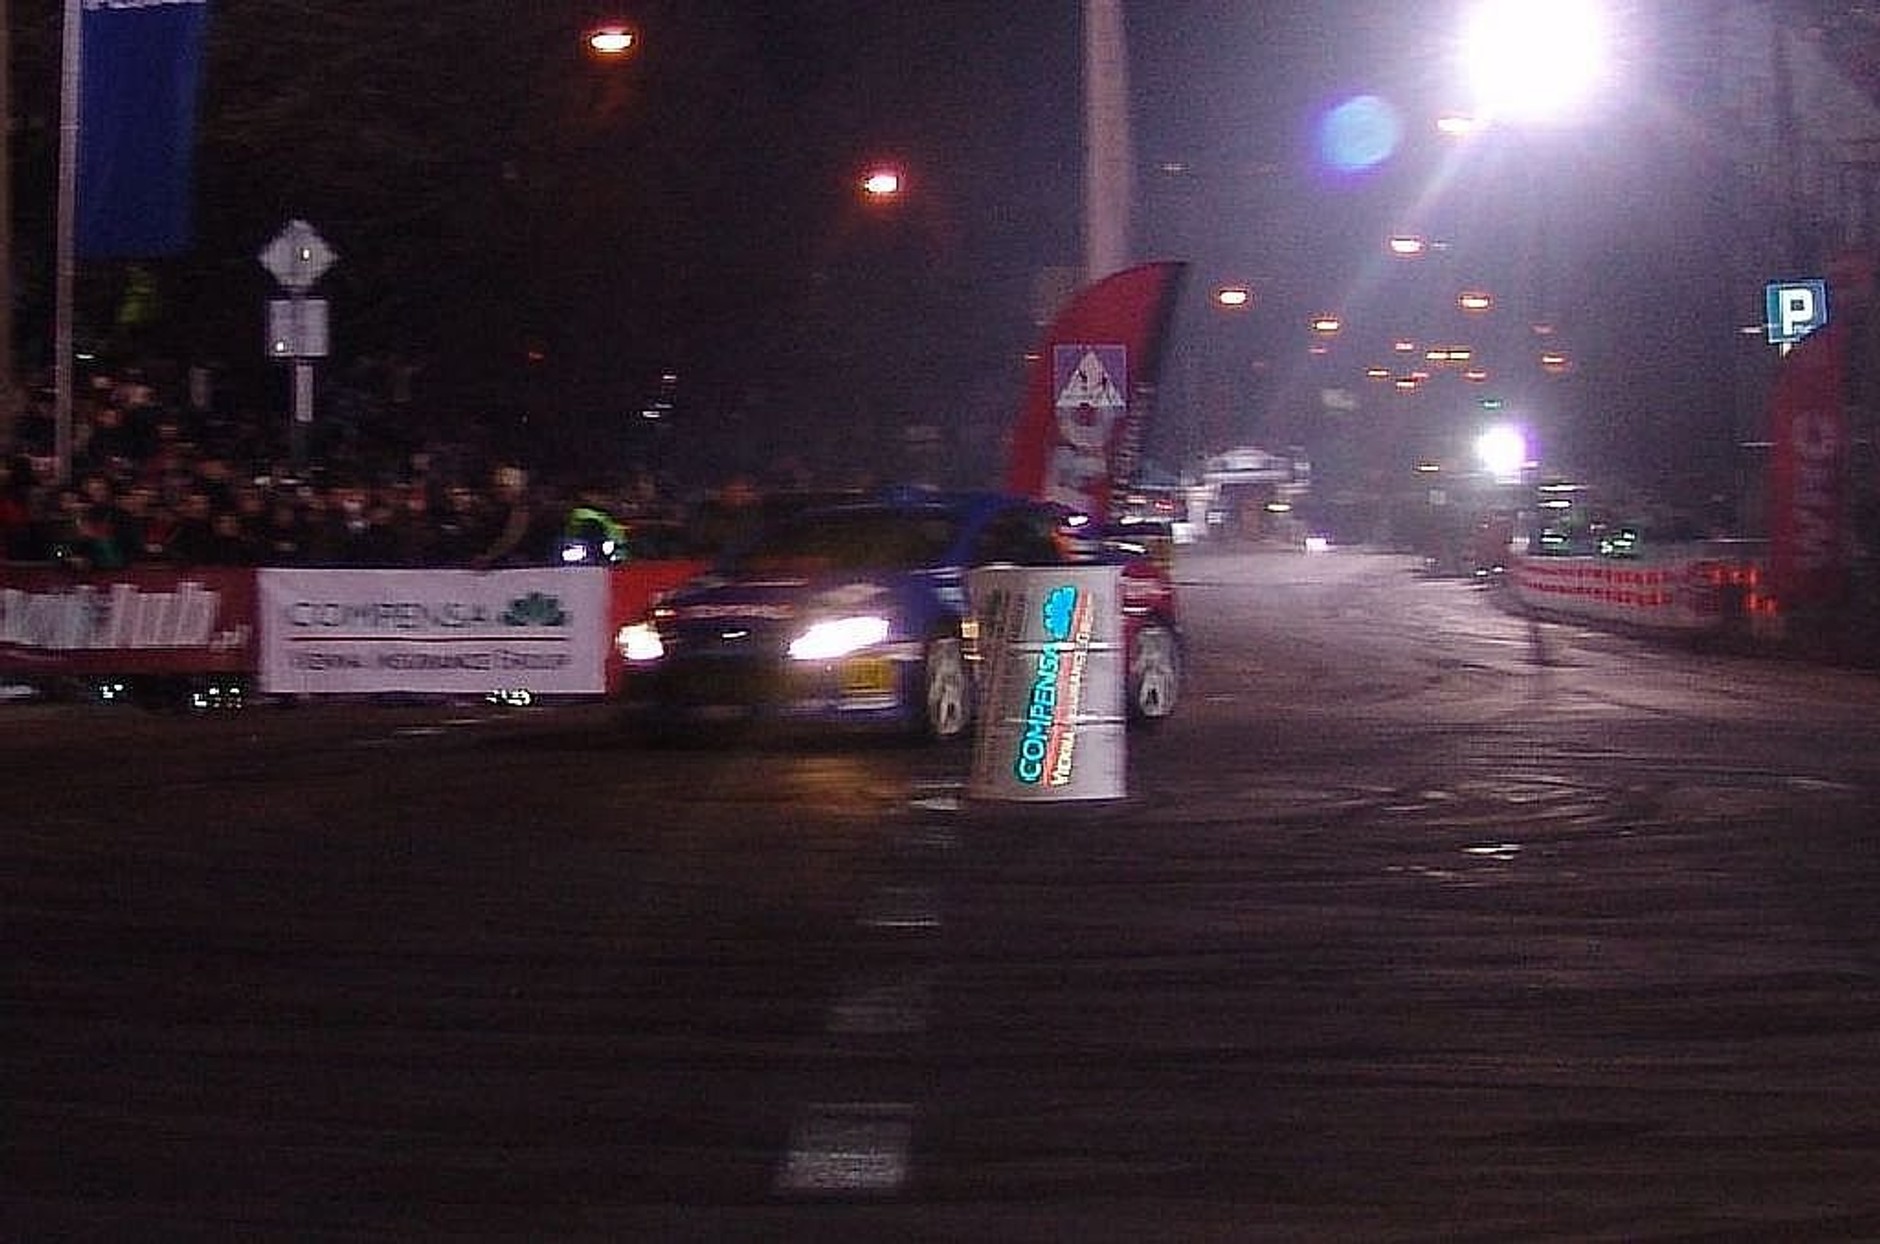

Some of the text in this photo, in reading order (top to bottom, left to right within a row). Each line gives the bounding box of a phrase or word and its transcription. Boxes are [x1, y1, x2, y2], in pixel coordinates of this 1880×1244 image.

[1782, 288, 1814, 336] P
[291, 601, 495, 629] COMPENSA
[1018, 642, 1060, 783] COMPENSA
